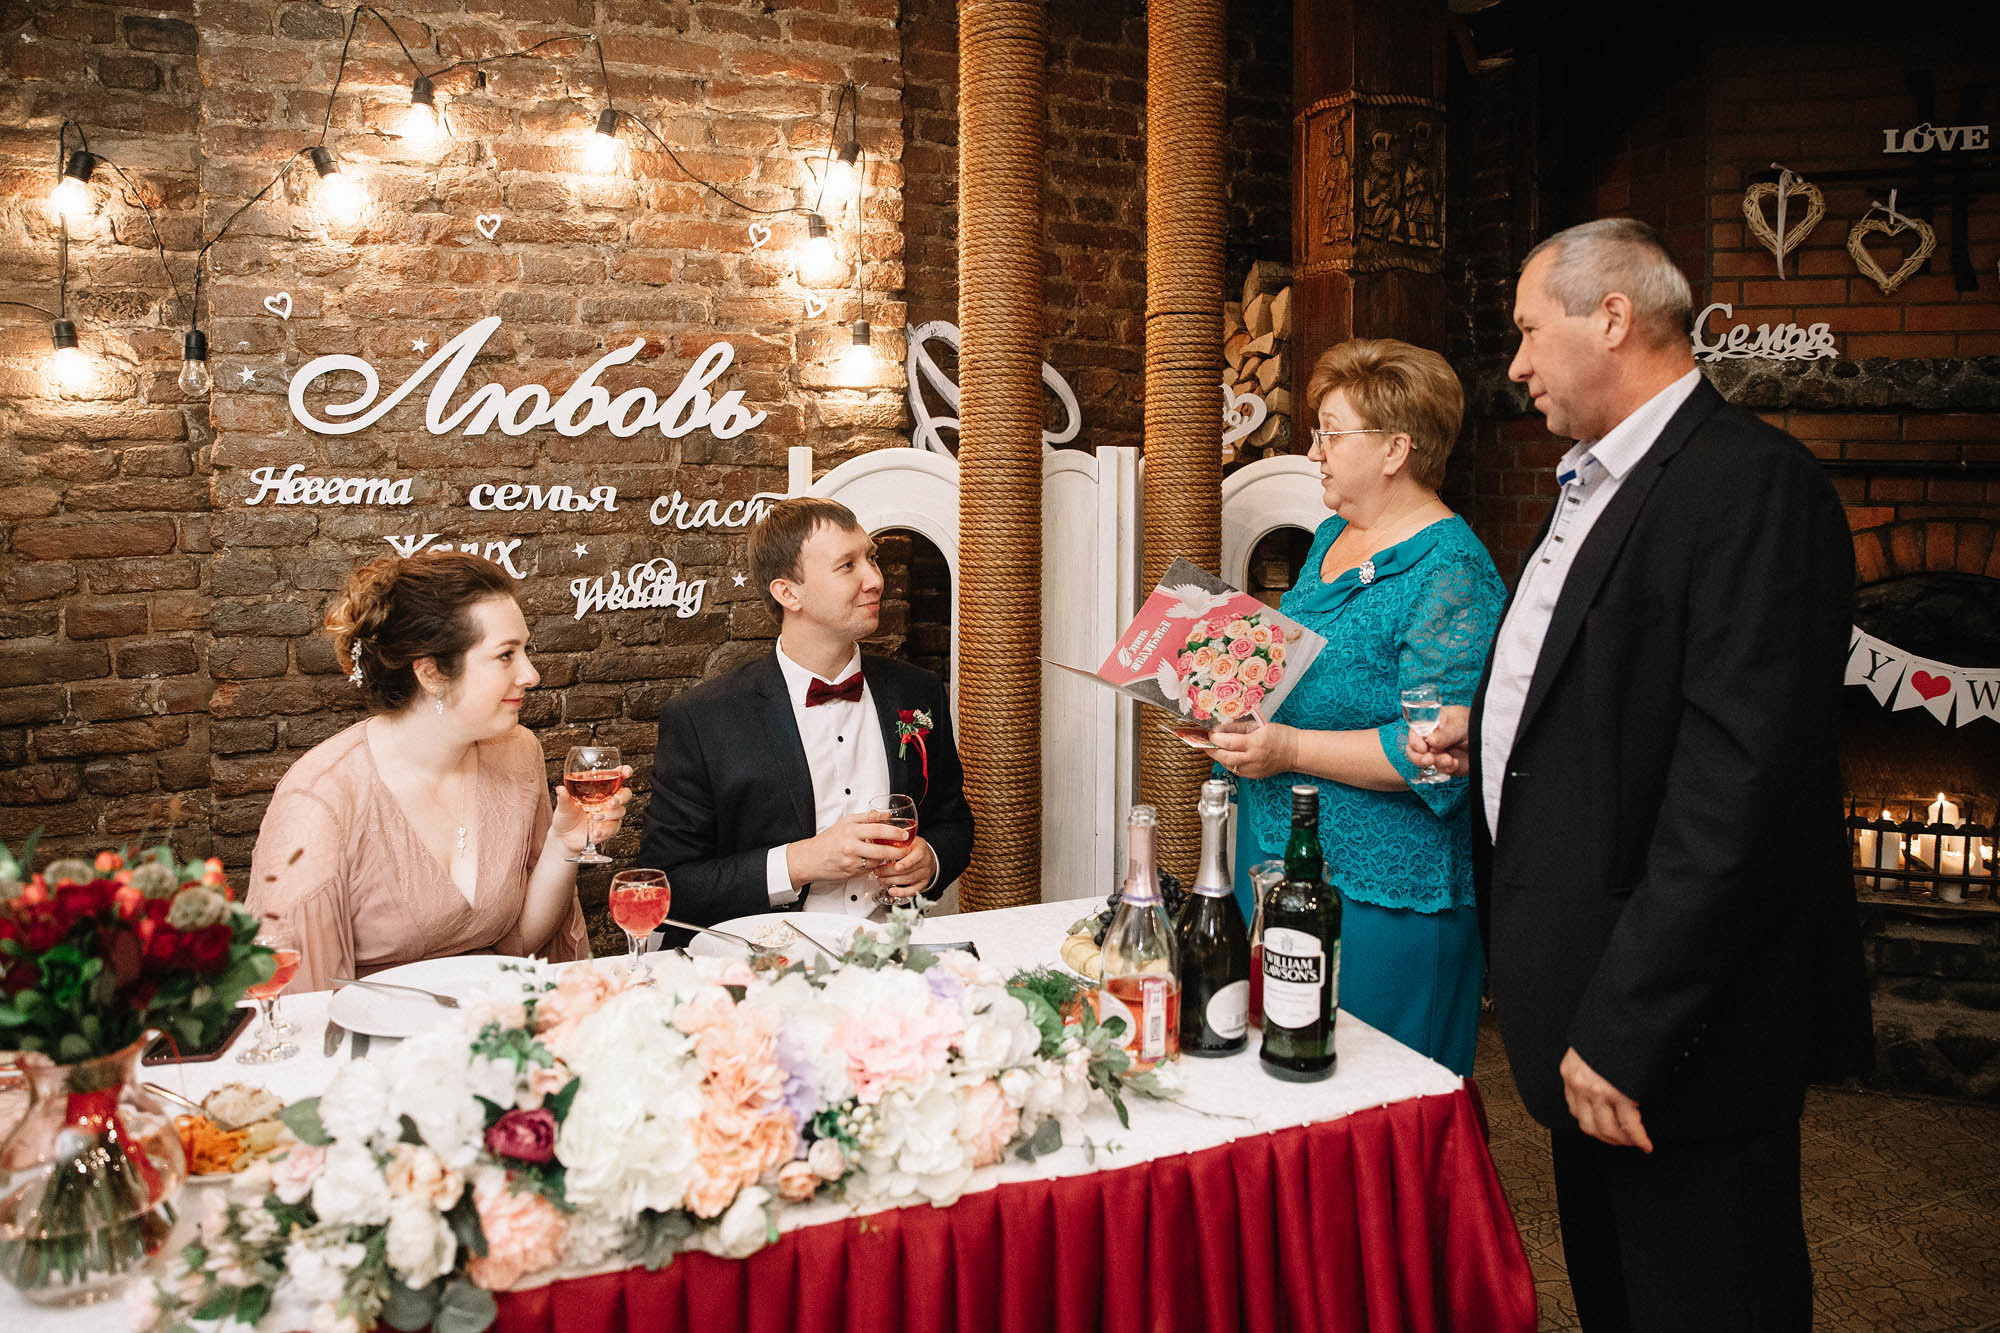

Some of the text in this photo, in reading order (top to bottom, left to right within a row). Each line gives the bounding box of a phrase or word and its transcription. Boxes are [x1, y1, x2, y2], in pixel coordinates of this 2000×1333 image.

[1882, 123, 1990, 153] LOVE
[1690, 302, 1838, 359] Семья
[288, 316, 767, 440] Любовь
[245, 463, 414, 506] Невеста
[469, 483, 620, 512] семья
[569, 557, 707, 621] Wedding
[1264, 961, 1319, 982] LAWSON'S
[1265, 951, 1313, 970] WILLIAM
